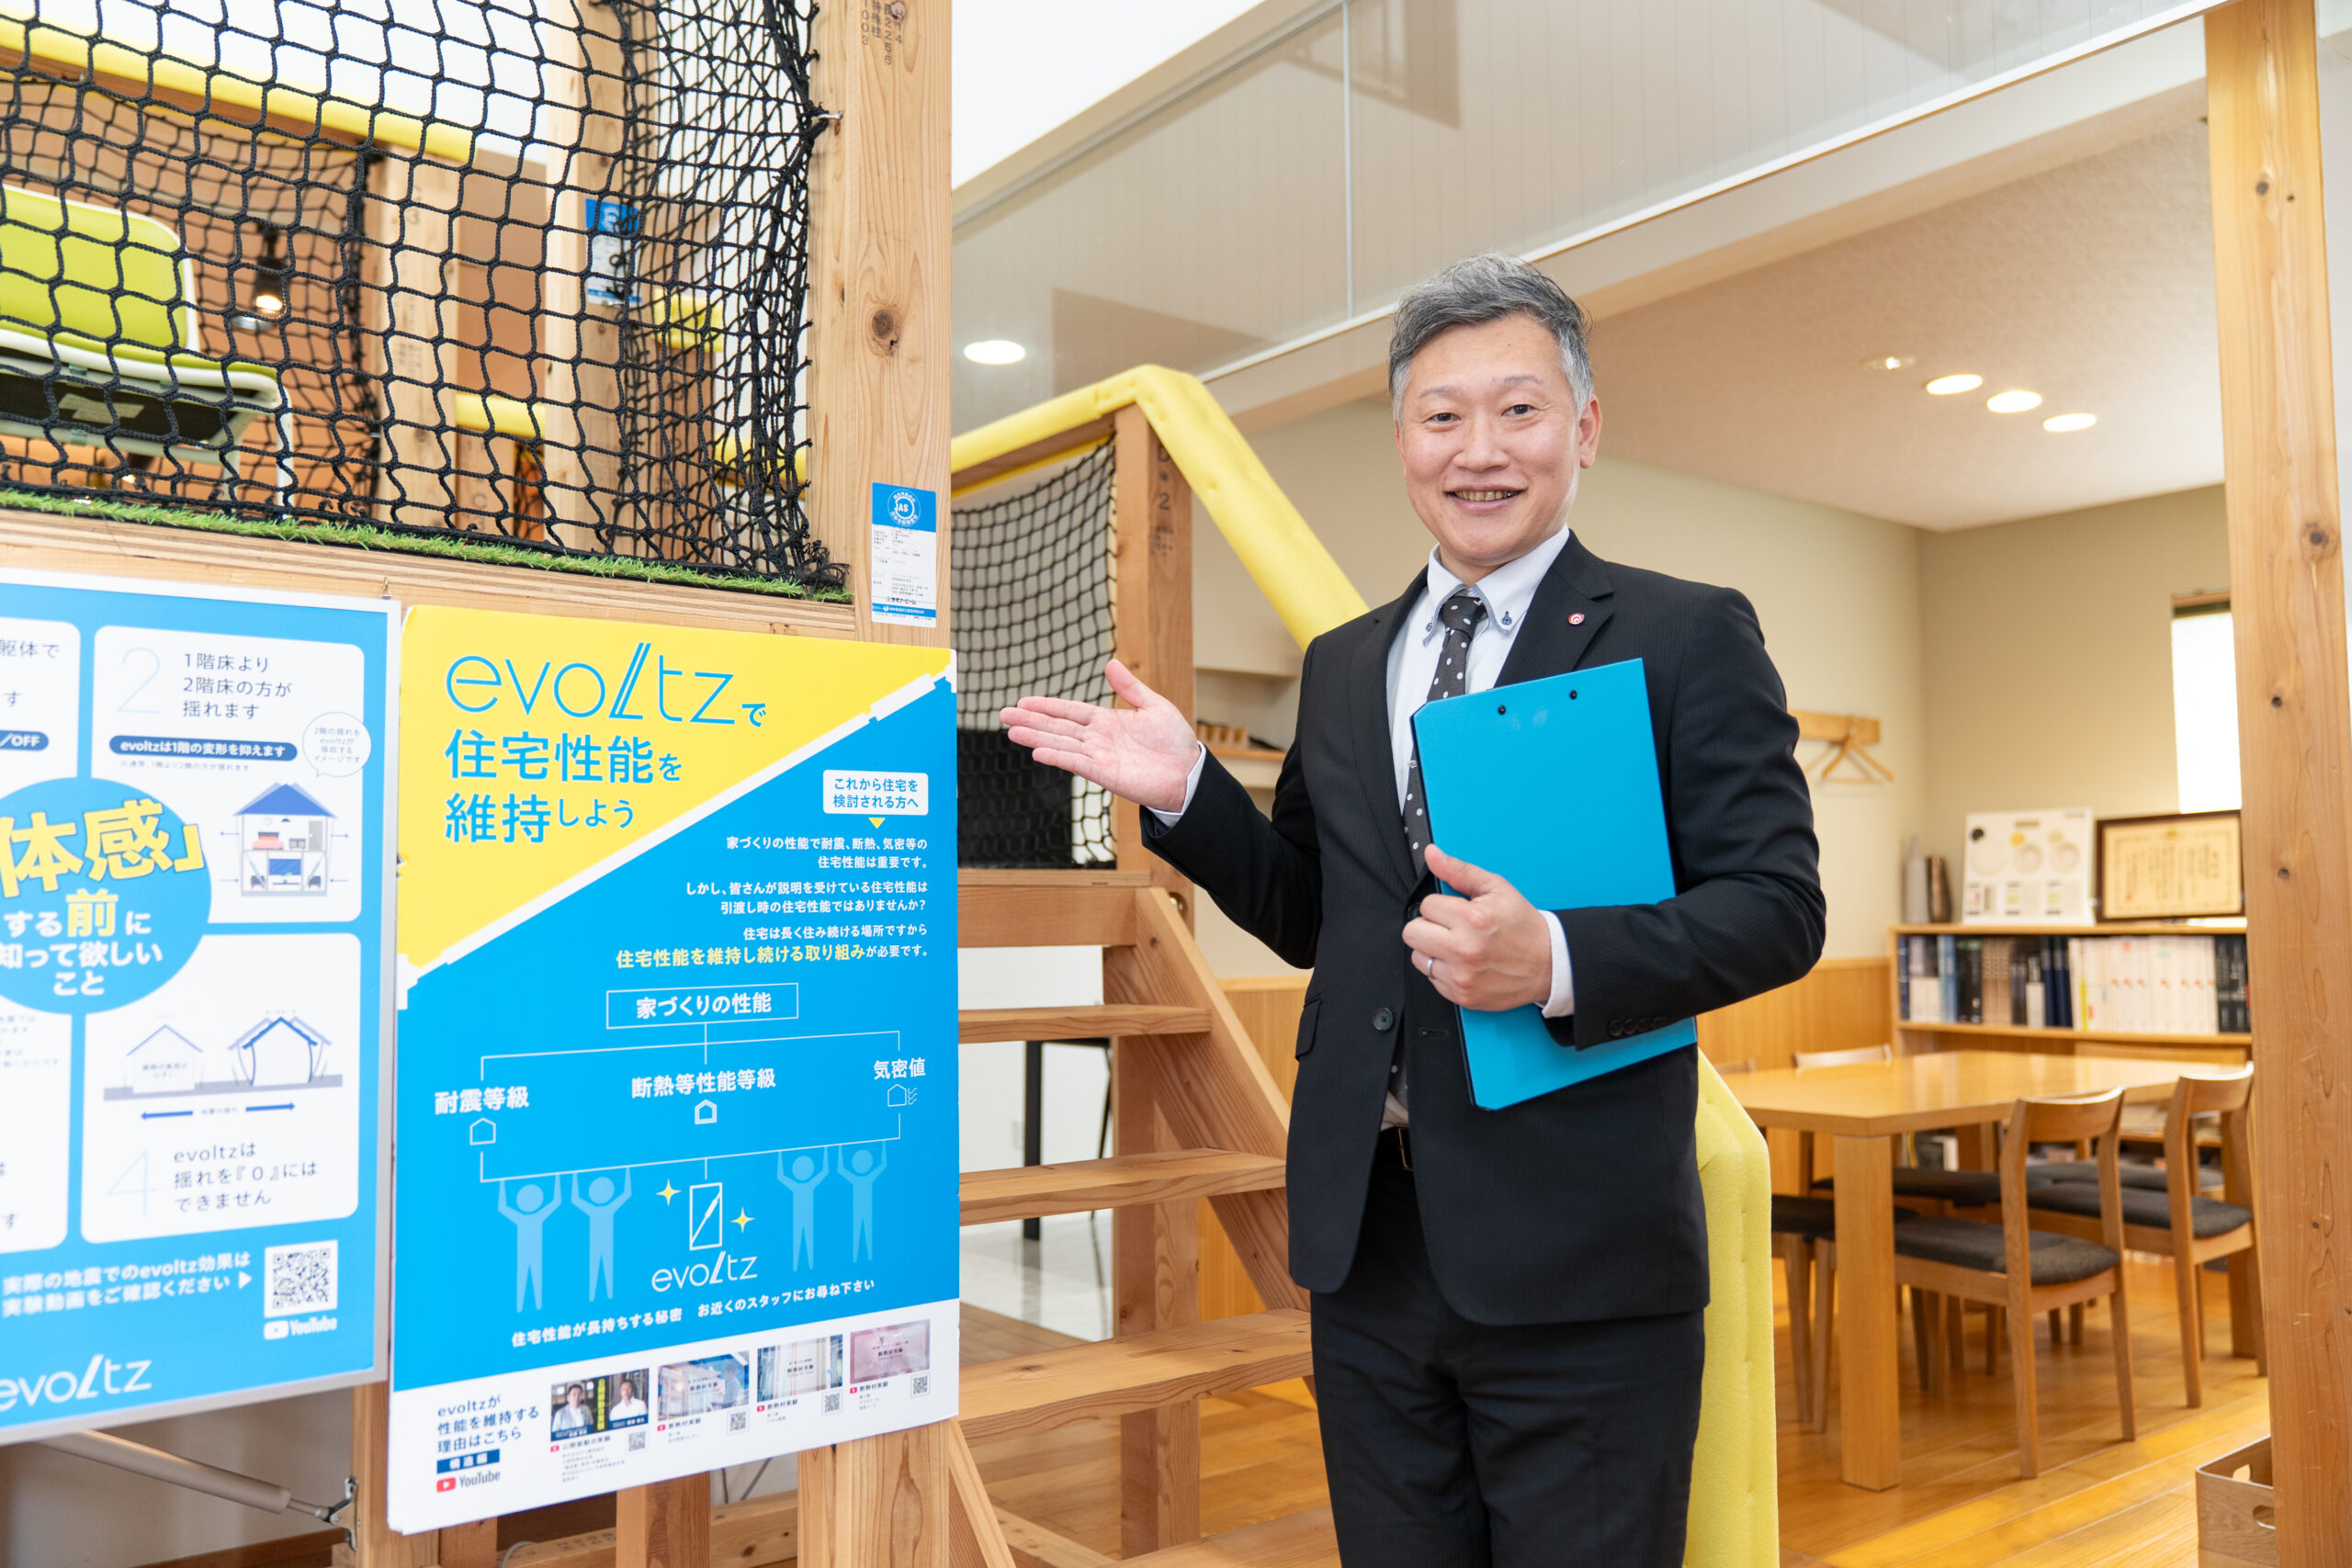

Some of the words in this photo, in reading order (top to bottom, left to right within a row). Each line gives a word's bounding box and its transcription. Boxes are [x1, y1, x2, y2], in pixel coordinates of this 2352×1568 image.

[184, 652, 270, 674] 1階床より
[118, 648, 161, 715] 2
[183, 676, 292, 698] 2階床の方が
[183, 700, 260, 721] 揺れます
[120, 739, 287, 759] evoltzは1階の変形を抑えます
[445, 728, 683, 784] 住宅性能を
[833, 777, 920, 794] これから住宅を
[832, 794, 920, 810] 検討される方へ
[445, 792, 635, 843] 維持しよう
[726, 836, 928, 851] 家づくりの性能で耐震、断熱、気密等の
[818, 855, 928, 869] 住宅性能は重要です。
[686, 880, 928, 896] しかし、皆さんが説明を受けている住宅性能は
[4, 887, 152, 938] する前に
[743, 923, 928, 941] 住宅は長く住み続ける場所ですから
[0, 942, 164, 969] 知って欲しい
[616, 943, 928, 969] 住宅性能を維持し続ける取り組みが必要です。
[53, 970, 106, 997] こと
[636, 992, 773, 1021] 家づくりの性能
[873, 1057, 927, 1081] 気密値
[630, 1067, 777, 1100] 断熱等性能等級
[434, 1085, 531, 1117] 耐震等級
[174, 1142, 257, 1164] evoltzは
[175, 1190, 273, 1214] できません
[2, 1250, 251, 1297] 実際の地震でのevoltz効果は
[651, 1249, 759, 1292] evoltz
[2, 1275, 231, 1318] 実験動画をご確認ください
[289, 1316, 338, 1337] YouTube
[511, 1307, 684, 1348] 住宅性能が長持ちする秘密
[697, 1279, 876, 1319] お近くのスタッフにお尋ね下さい
[0, 1353, 153, 1413] evoltz
[437, 1393, 503, 1418] evoltzが
[437, 1405, 539, 1437] 性能を維持する
[437, 1427, 522, 1454] 理由はこちら
[459, 1470, 502, 1489] YouTube
